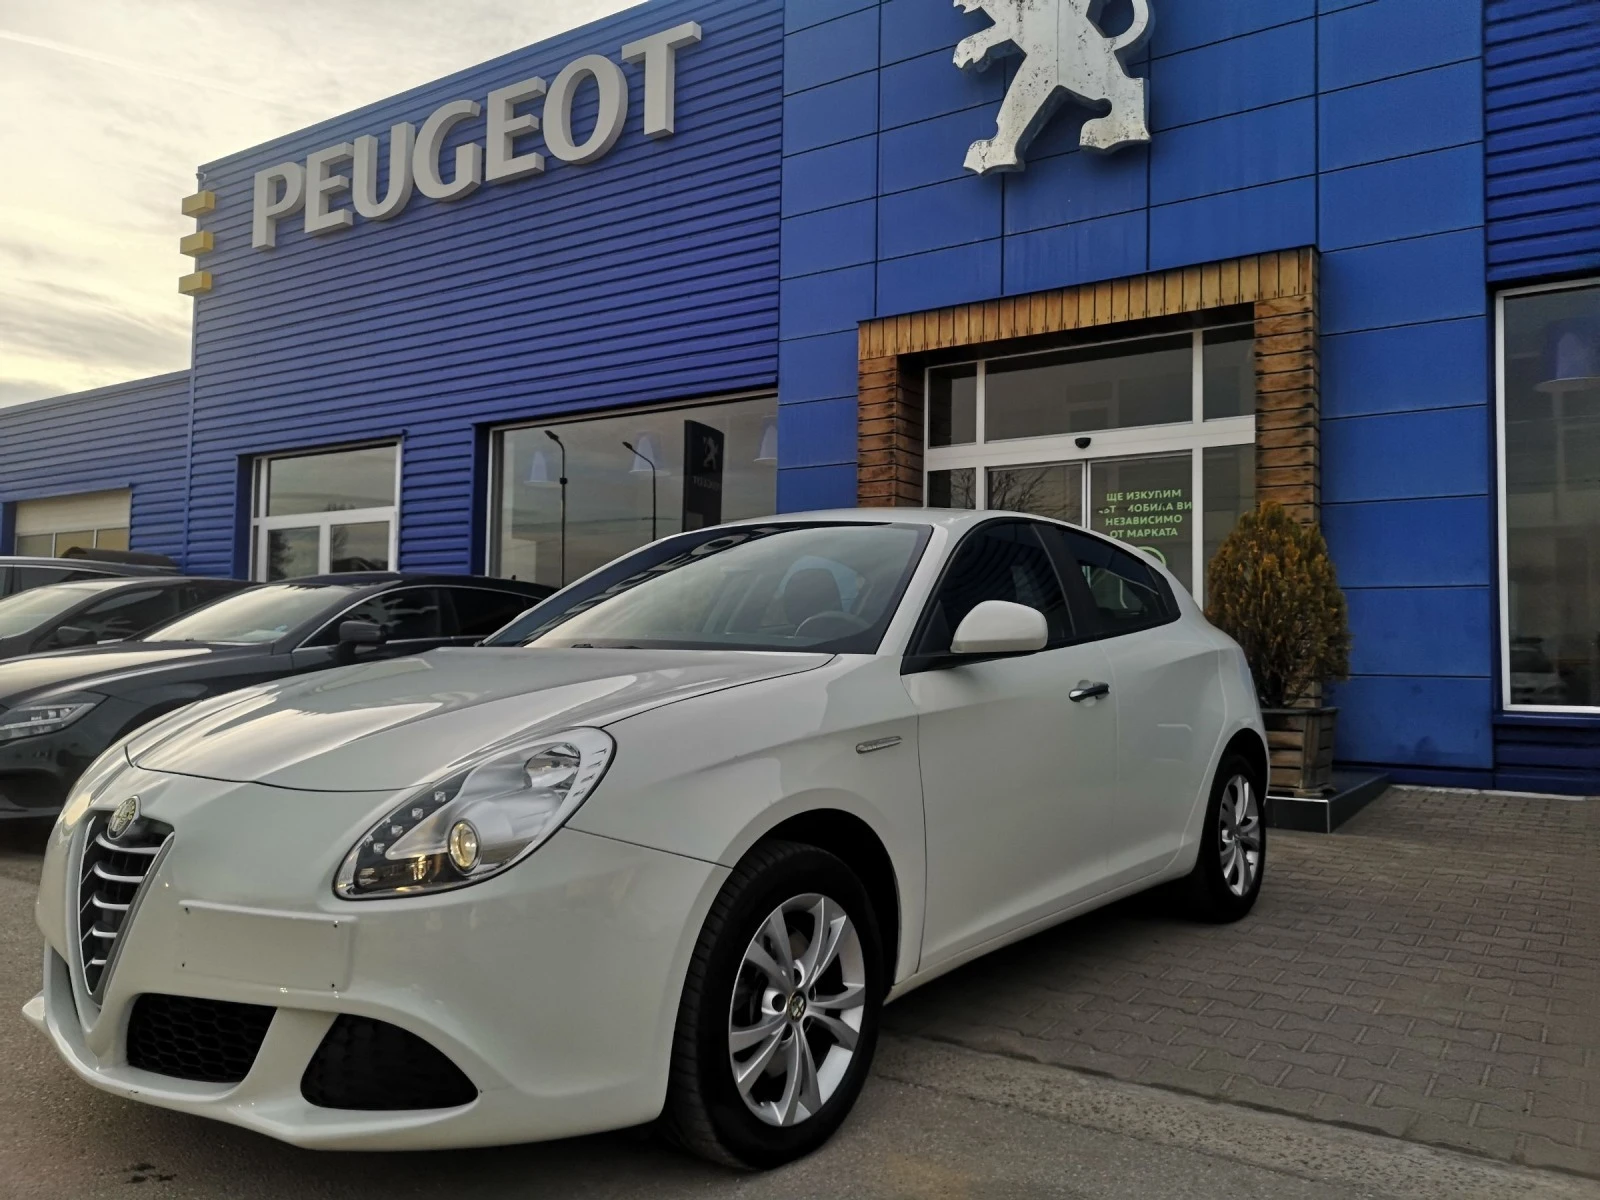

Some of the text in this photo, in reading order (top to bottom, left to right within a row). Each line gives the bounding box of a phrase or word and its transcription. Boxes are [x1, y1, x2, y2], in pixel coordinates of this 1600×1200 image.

[251, 21, 702, 249] PEUGEOT
[1106, 489, 1181, 502] ЩЕ ИЗКУПИМ
[1177, 502, 1192, 510] ВИ
[1105, 515, 1182, 526] НЕЗАВИСИМО
[1110, 527, 1178, 539] ОТ МАРКАТА
